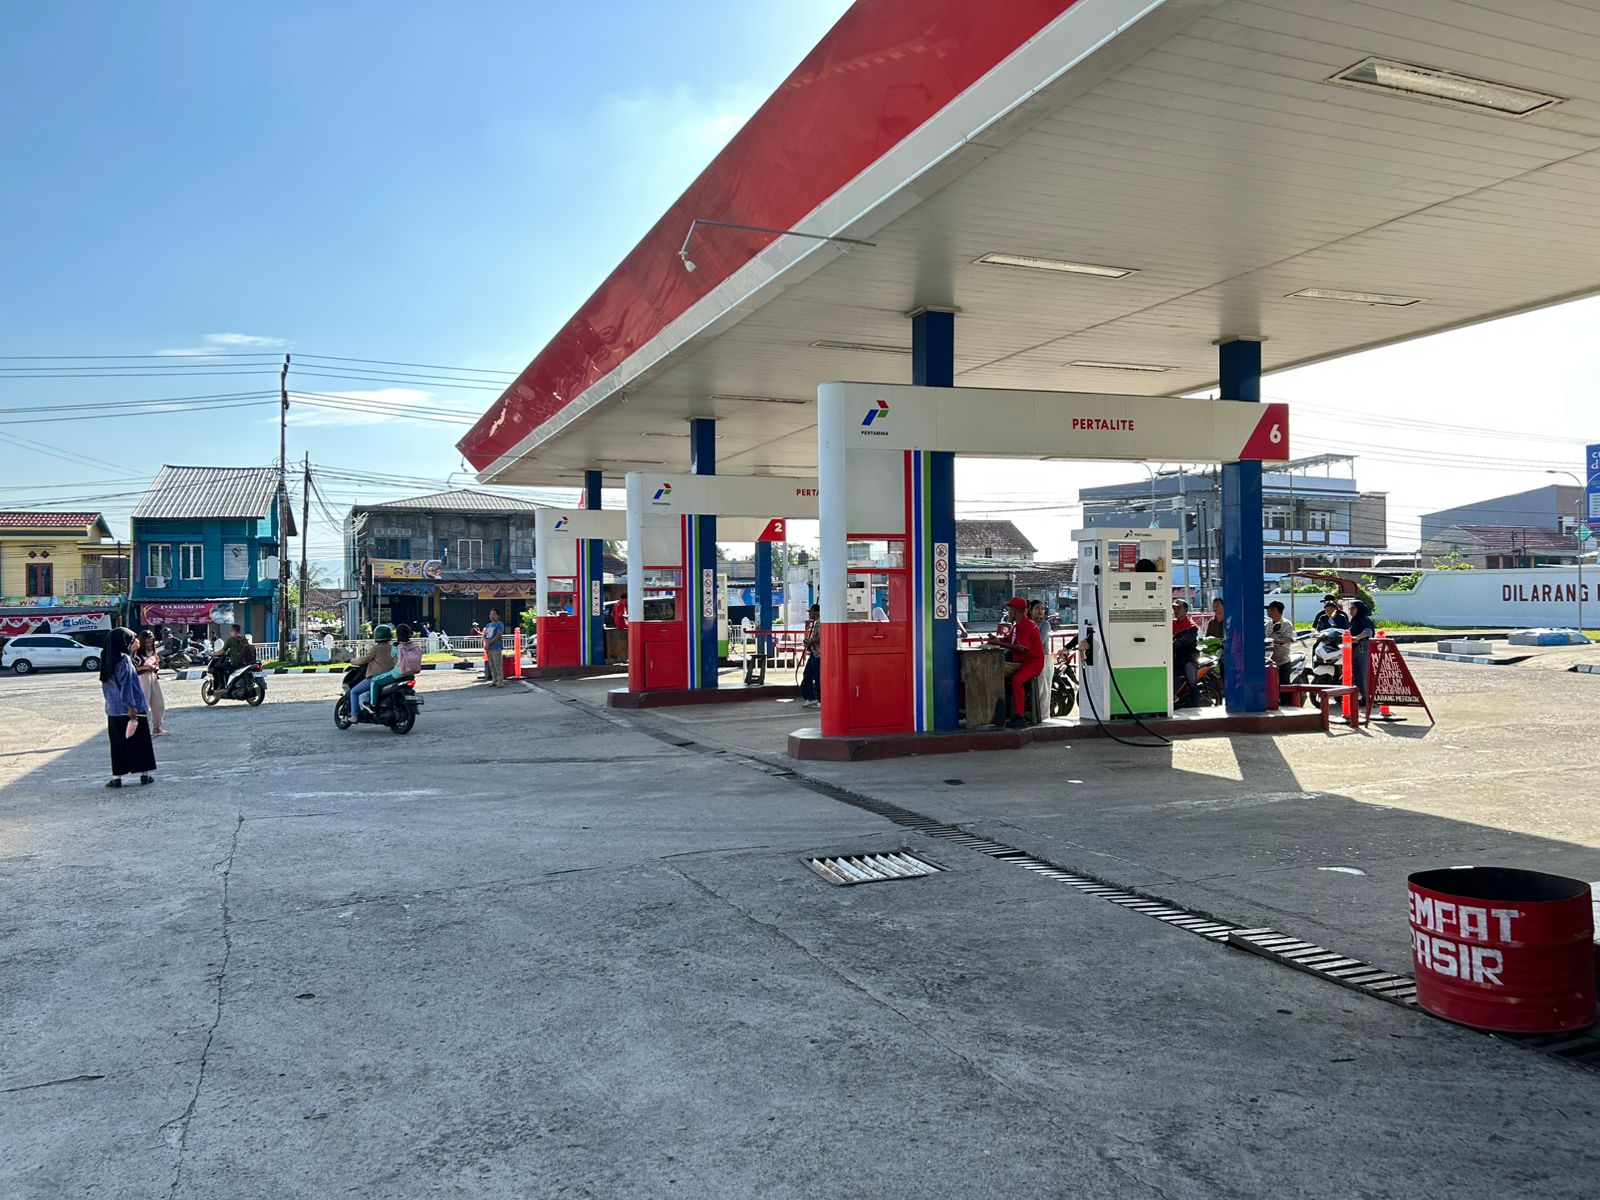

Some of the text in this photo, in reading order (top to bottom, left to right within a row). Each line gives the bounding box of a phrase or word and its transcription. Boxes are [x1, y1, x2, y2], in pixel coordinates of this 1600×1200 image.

[1072, 418, 1134, 431] PERTALITE
[1269, 424, 1282, 444] 6
[774, 523, 783, 532] 2
[1502, 584, 1589, 602] DILARANG
